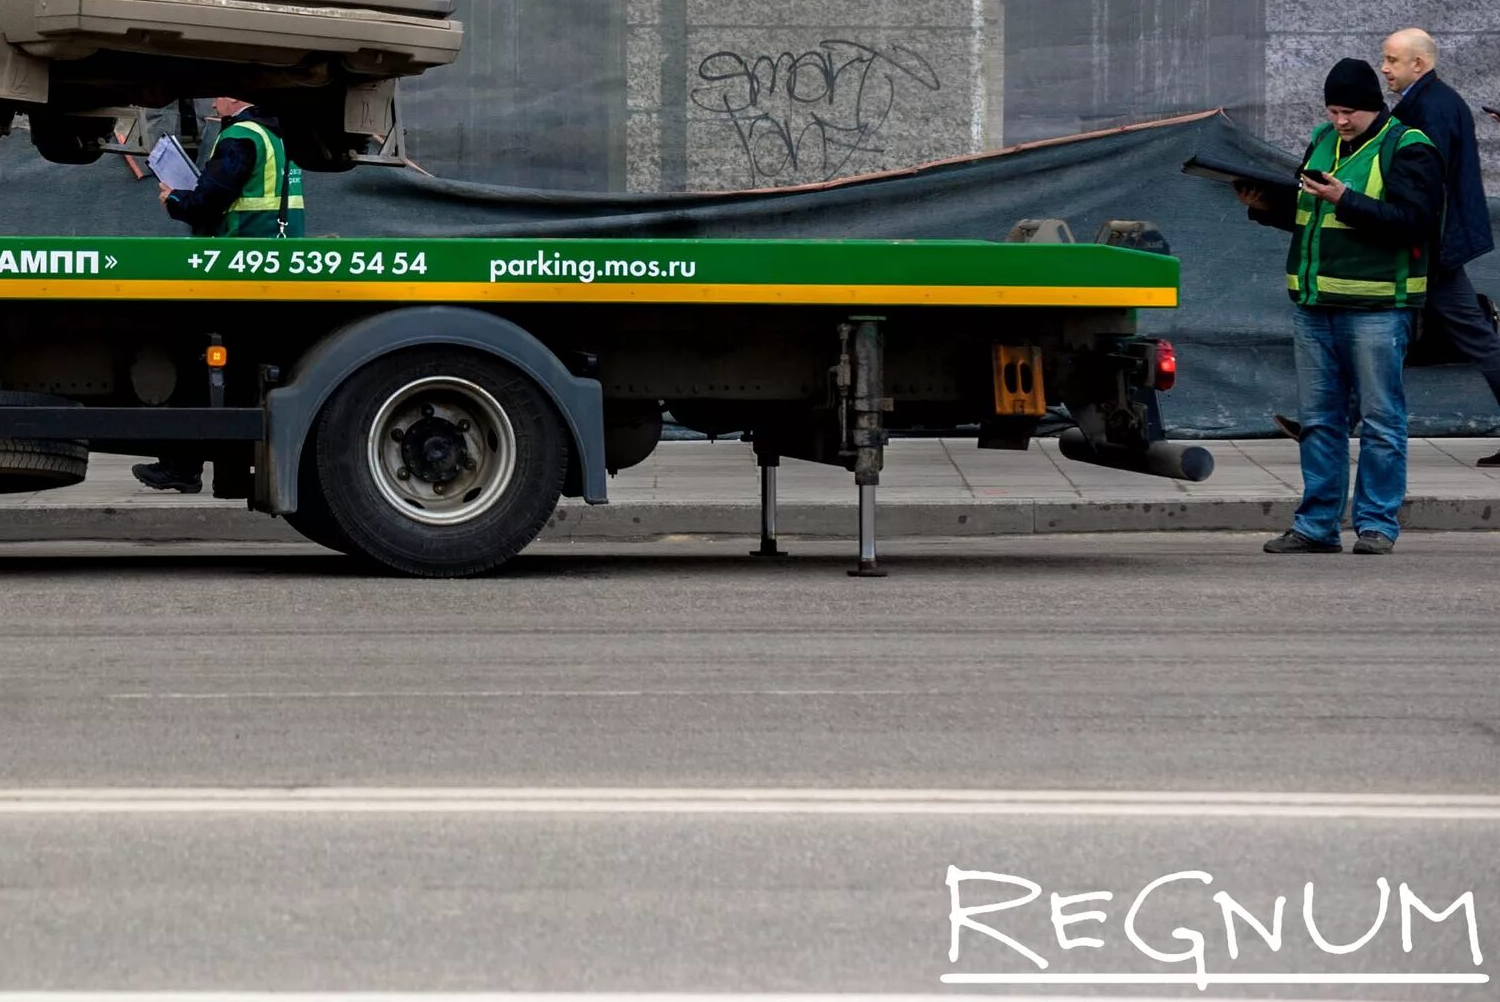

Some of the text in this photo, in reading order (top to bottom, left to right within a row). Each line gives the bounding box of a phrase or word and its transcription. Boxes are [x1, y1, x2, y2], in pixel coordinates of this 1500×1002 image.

[187, 251, 427, 274] +7 495 539 54 54
[490, 250, 696, 283] parking.mos.ru
